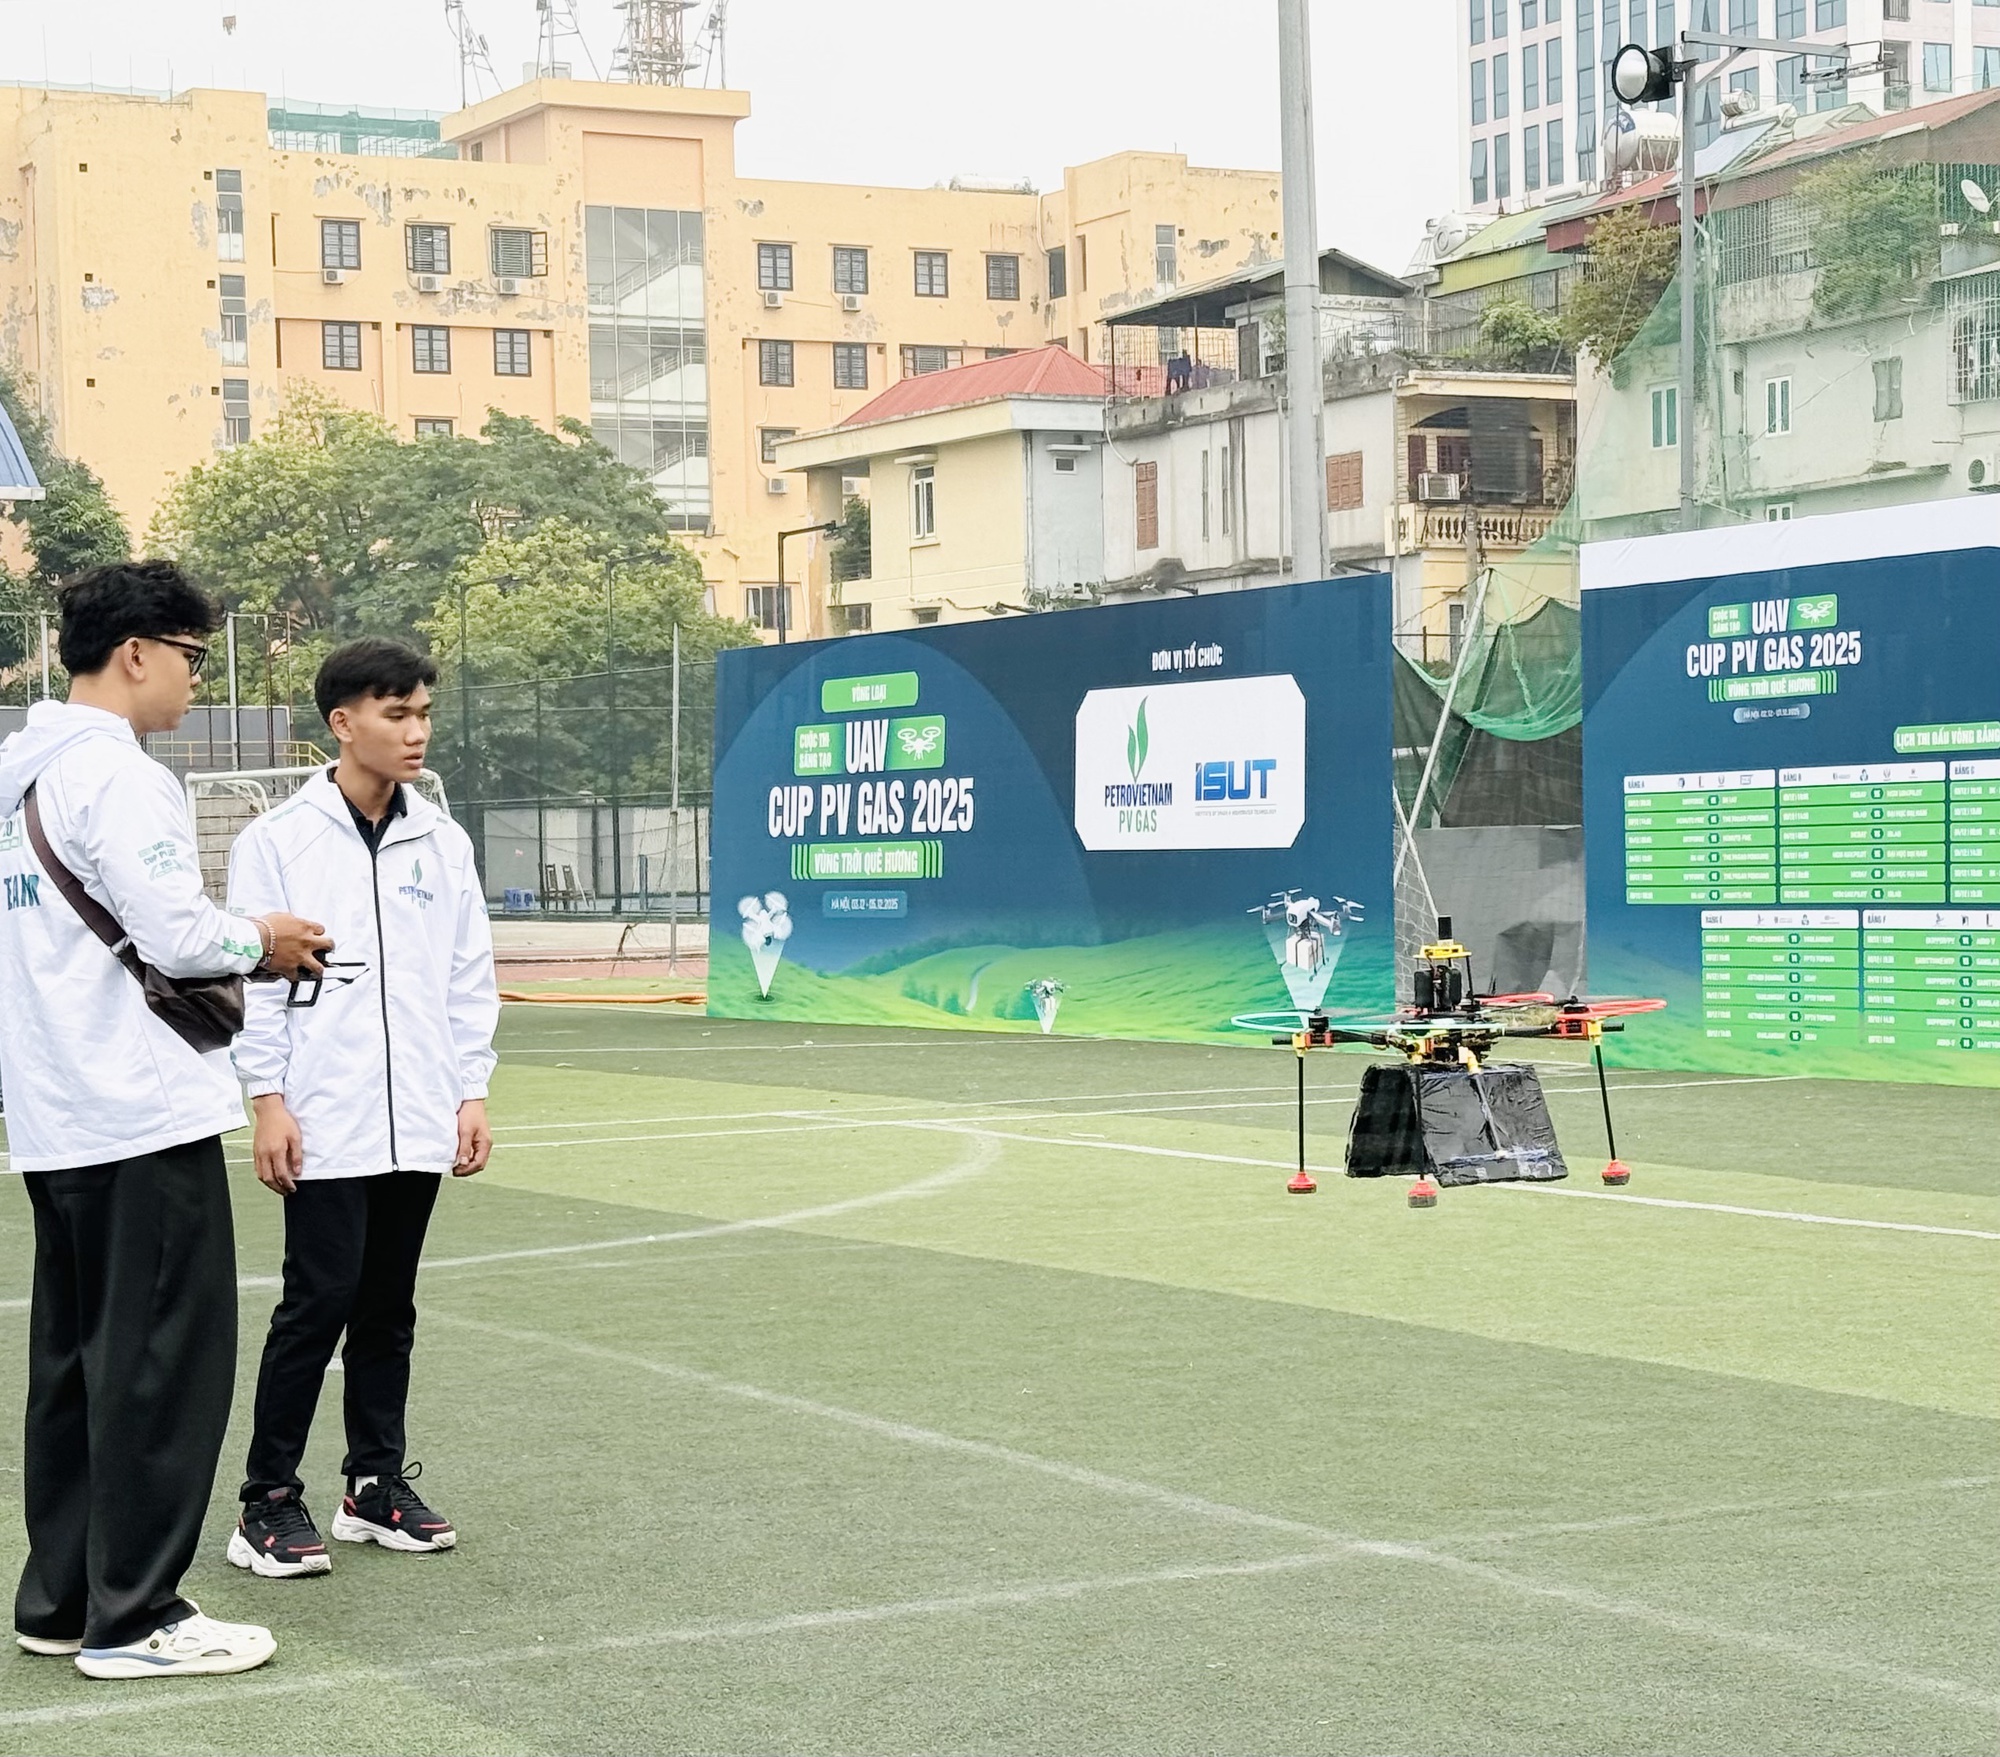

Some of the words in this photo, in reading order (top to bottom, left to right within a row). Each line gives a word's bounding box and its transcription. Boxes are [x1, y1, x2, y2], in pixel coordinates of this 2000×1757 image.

[1752, 598, 1790, 634] UAV
[1173, 650, 1182, 673] VỊ
[1198, 642, 1223, 667] CHỨC
[1686, 643, 1726, 677] CUP
[1732, 639, 1758, 673] PV
[1763, 635, 1804, 672] GAS
[1810, 630, 1862, 667] 2025
[871, 684, 887, 703] LOẠI
[1728, 681, 1750, 697] VÙNG
[1770, 677, 1787, 695] QUÊ
[800, 730, 818, 752] CUỘC
[819, 732, 830, 748] THI
[845, 718, 889, 774] UAV
[1896, 732, 1915, 750] LỊCH
[1917, 731, 1930, 746] THI
[1951, 727, 1974, 744] VÒNG
[768, 785, 814, 838] CUP
[820, 783, 851, 836] PV
[857, 780, 905, 836] GAS
[911, 777, 974, 833] 2025
[1105, 783, 1172, 807] PETROVIETNAM
[1119, 809, 1132, 833] PV
[1135, 809, 1157, 833] GAS
[814, 849, 839, 874] VÙNG
[841, 847, 862, 873] TRỜI
[864, 847, 882, 876] QUÊ
[884, 850, 918, 873] HƯƠNG
